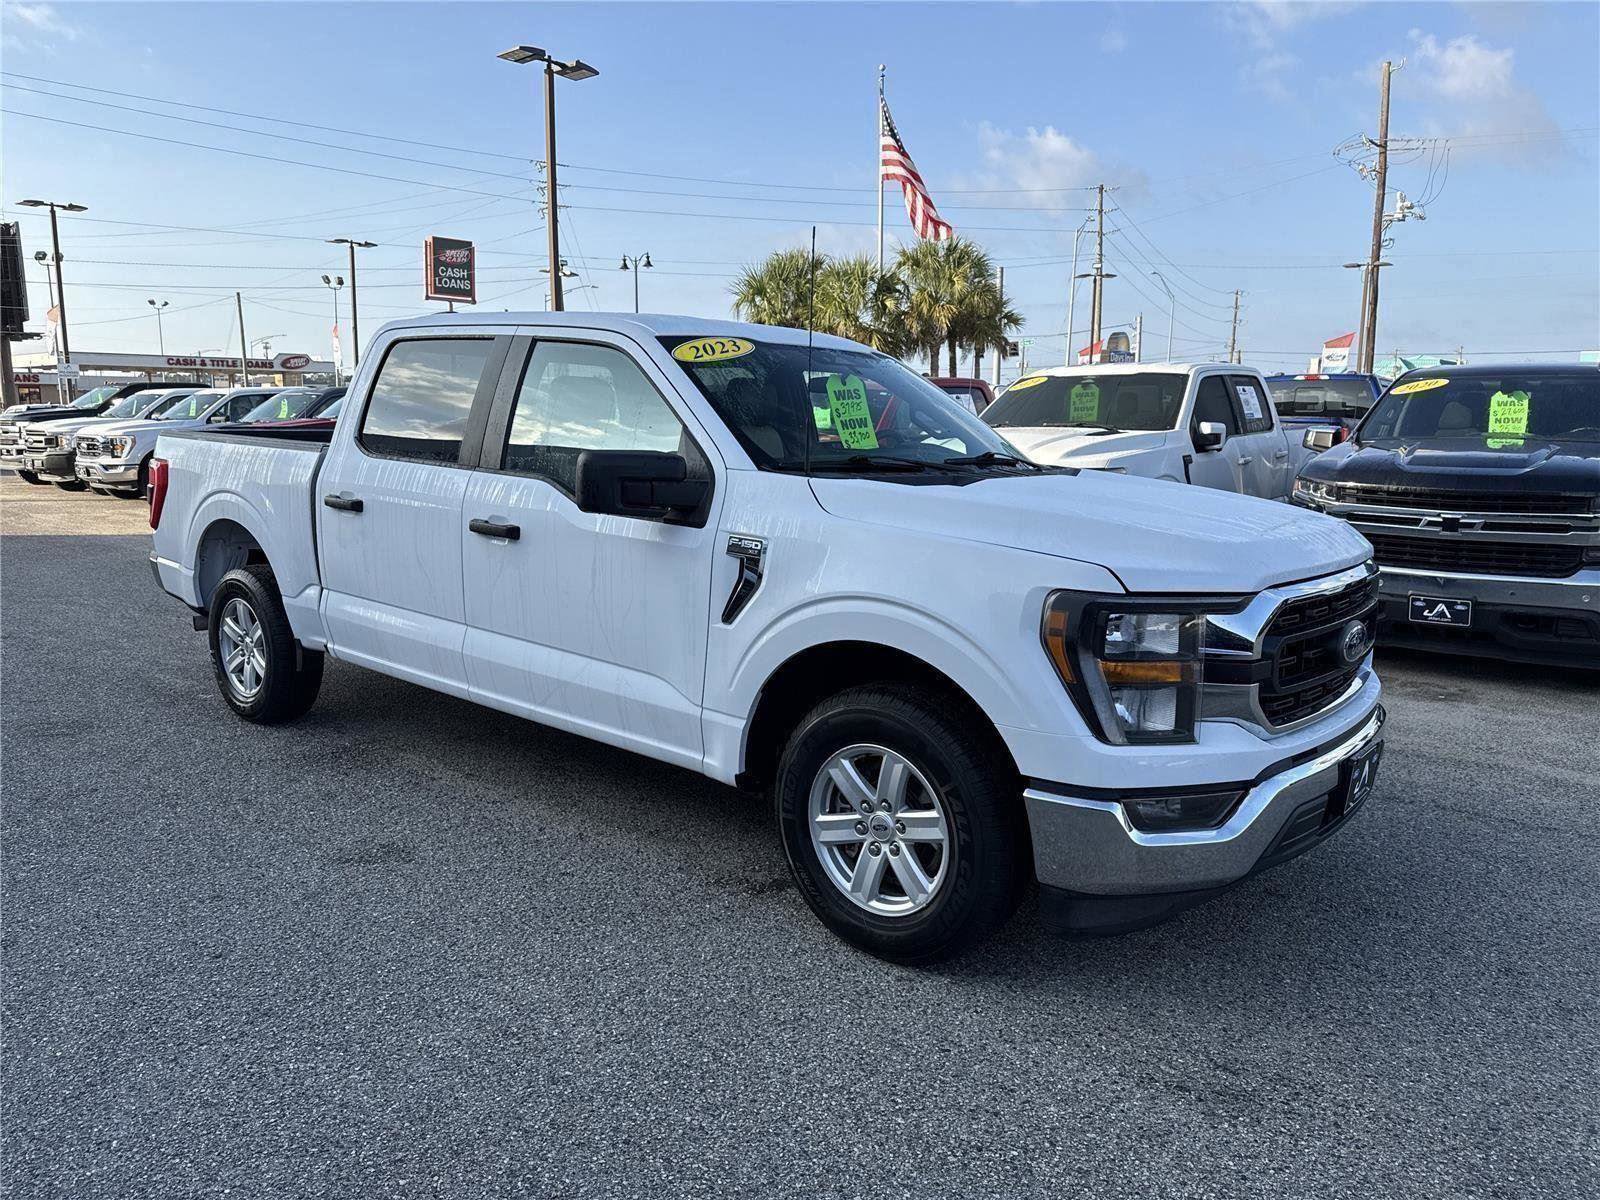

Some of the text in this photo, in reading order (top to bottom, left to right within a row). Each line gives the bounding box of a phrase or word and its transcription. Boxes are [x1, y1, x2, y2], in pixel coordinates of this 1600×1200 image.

[439, 266, 467, 278] CASH
[436, 277, 470, 289] LOANS
[689, 340, 740, 359] 2023
[166, 357, 197, 367] CASH
[200, 358, 207, 367] &
[209, 359, 239, 368] TITLE
[14, 374, 40, 383] ANS
[833, 388, 861, 401] WAS
[840, 416, 868, 431] NOW
[729, 537, 762, 550] F-150
